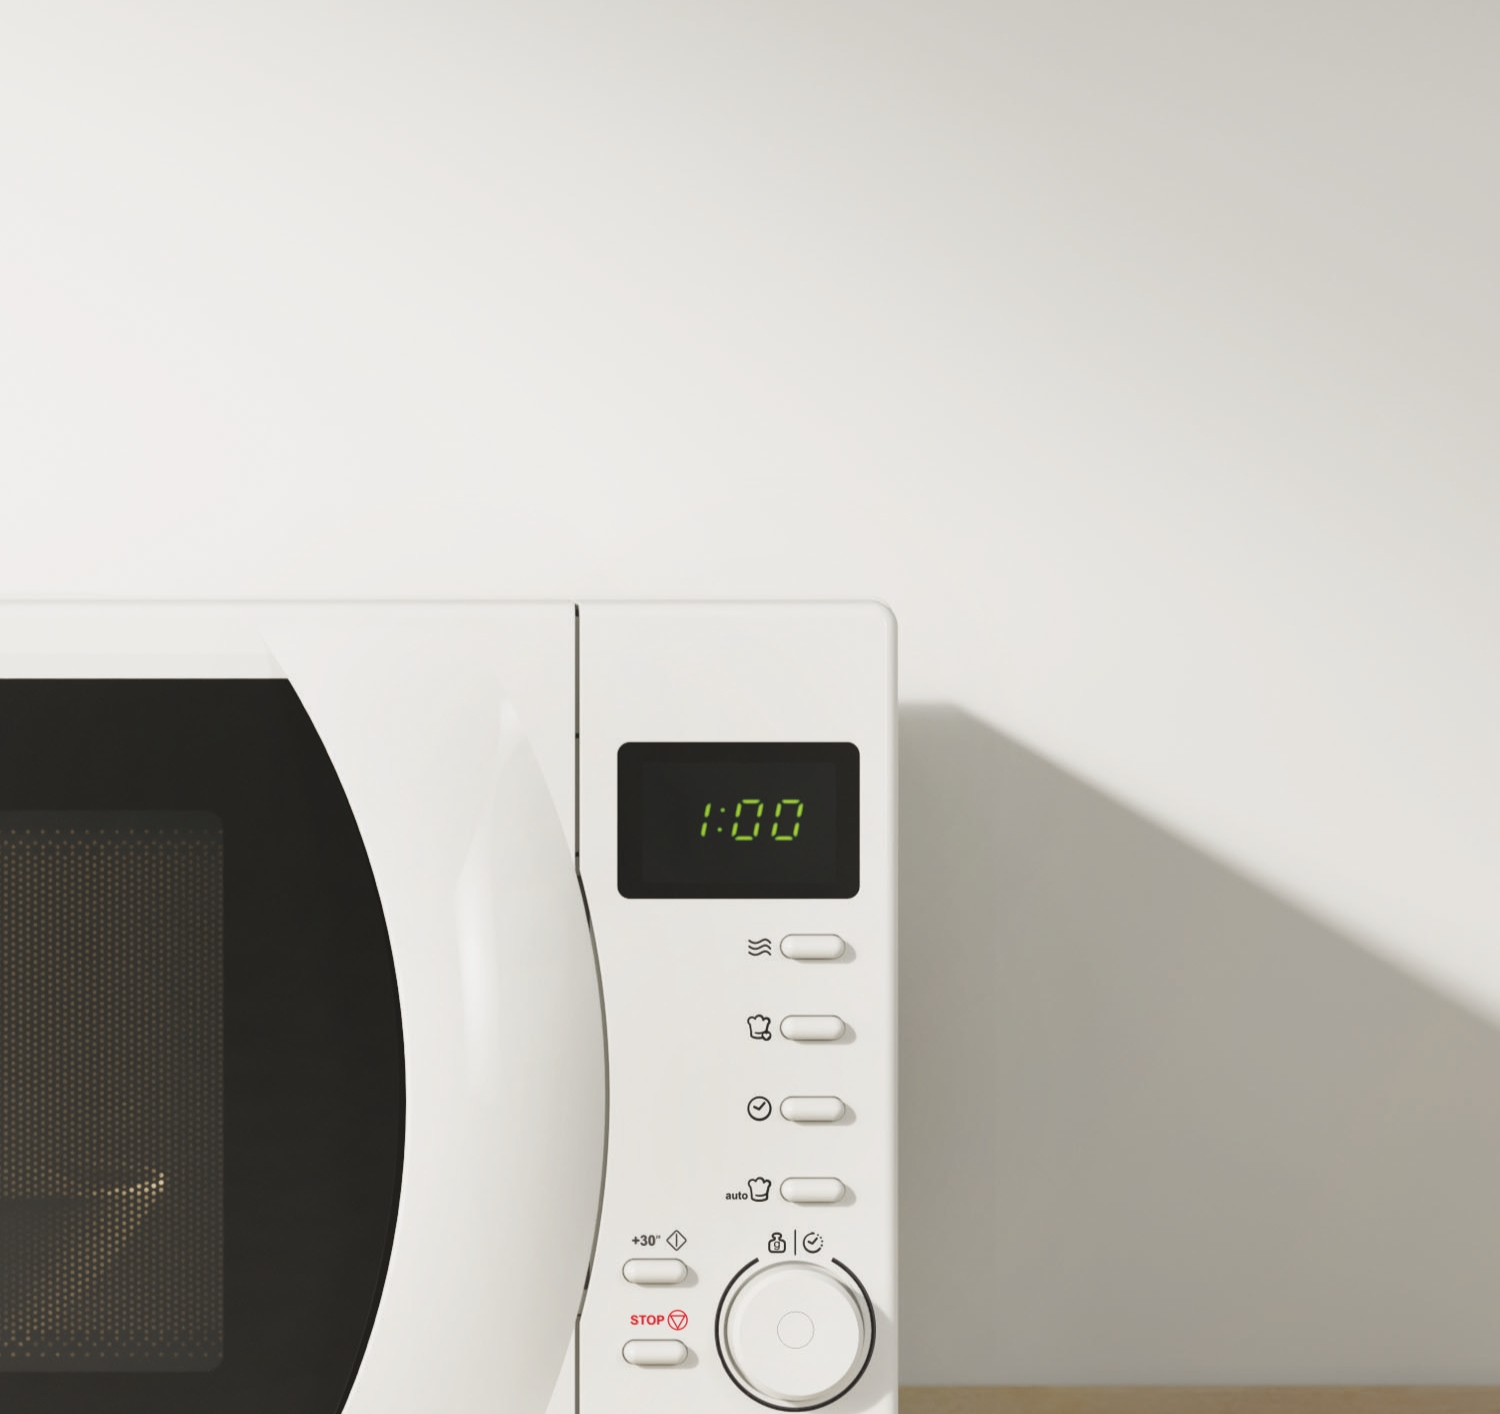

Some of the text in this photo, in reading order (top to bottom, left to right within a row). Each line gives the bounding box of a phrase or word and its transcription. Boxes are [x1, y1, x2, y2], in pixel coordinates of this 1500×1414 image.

[700, 799, 804, 841] 1:00
[725, 1191, 749, 1200] auto
[630, 1314, 665, 1326] STOP
